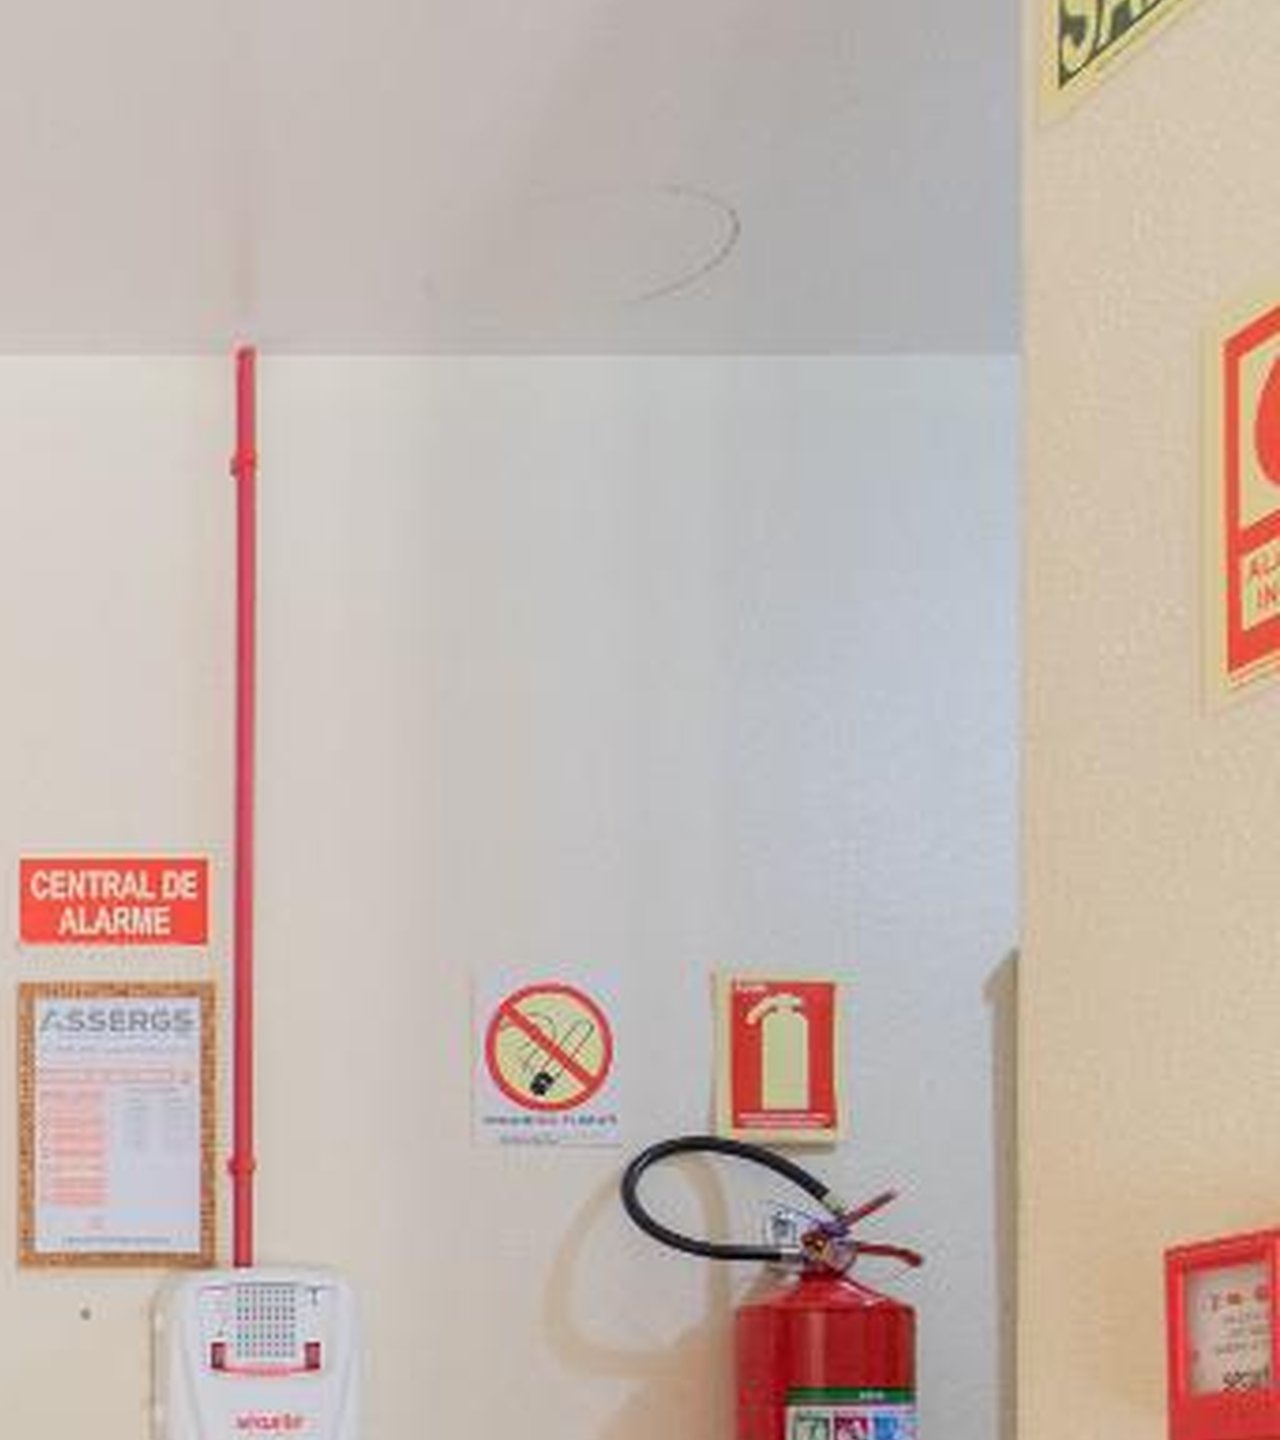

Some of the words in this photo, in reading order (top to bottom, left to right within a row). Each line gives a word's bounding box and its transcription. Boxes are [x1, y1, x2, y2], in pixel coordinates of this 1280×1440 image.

[30, 869, 157, 901] CENTRAL
[161, 869, 198, 900] DE
[57, 906, 171, 935] ALARME
[39, 1008, 195, 1033] ASSERGS
